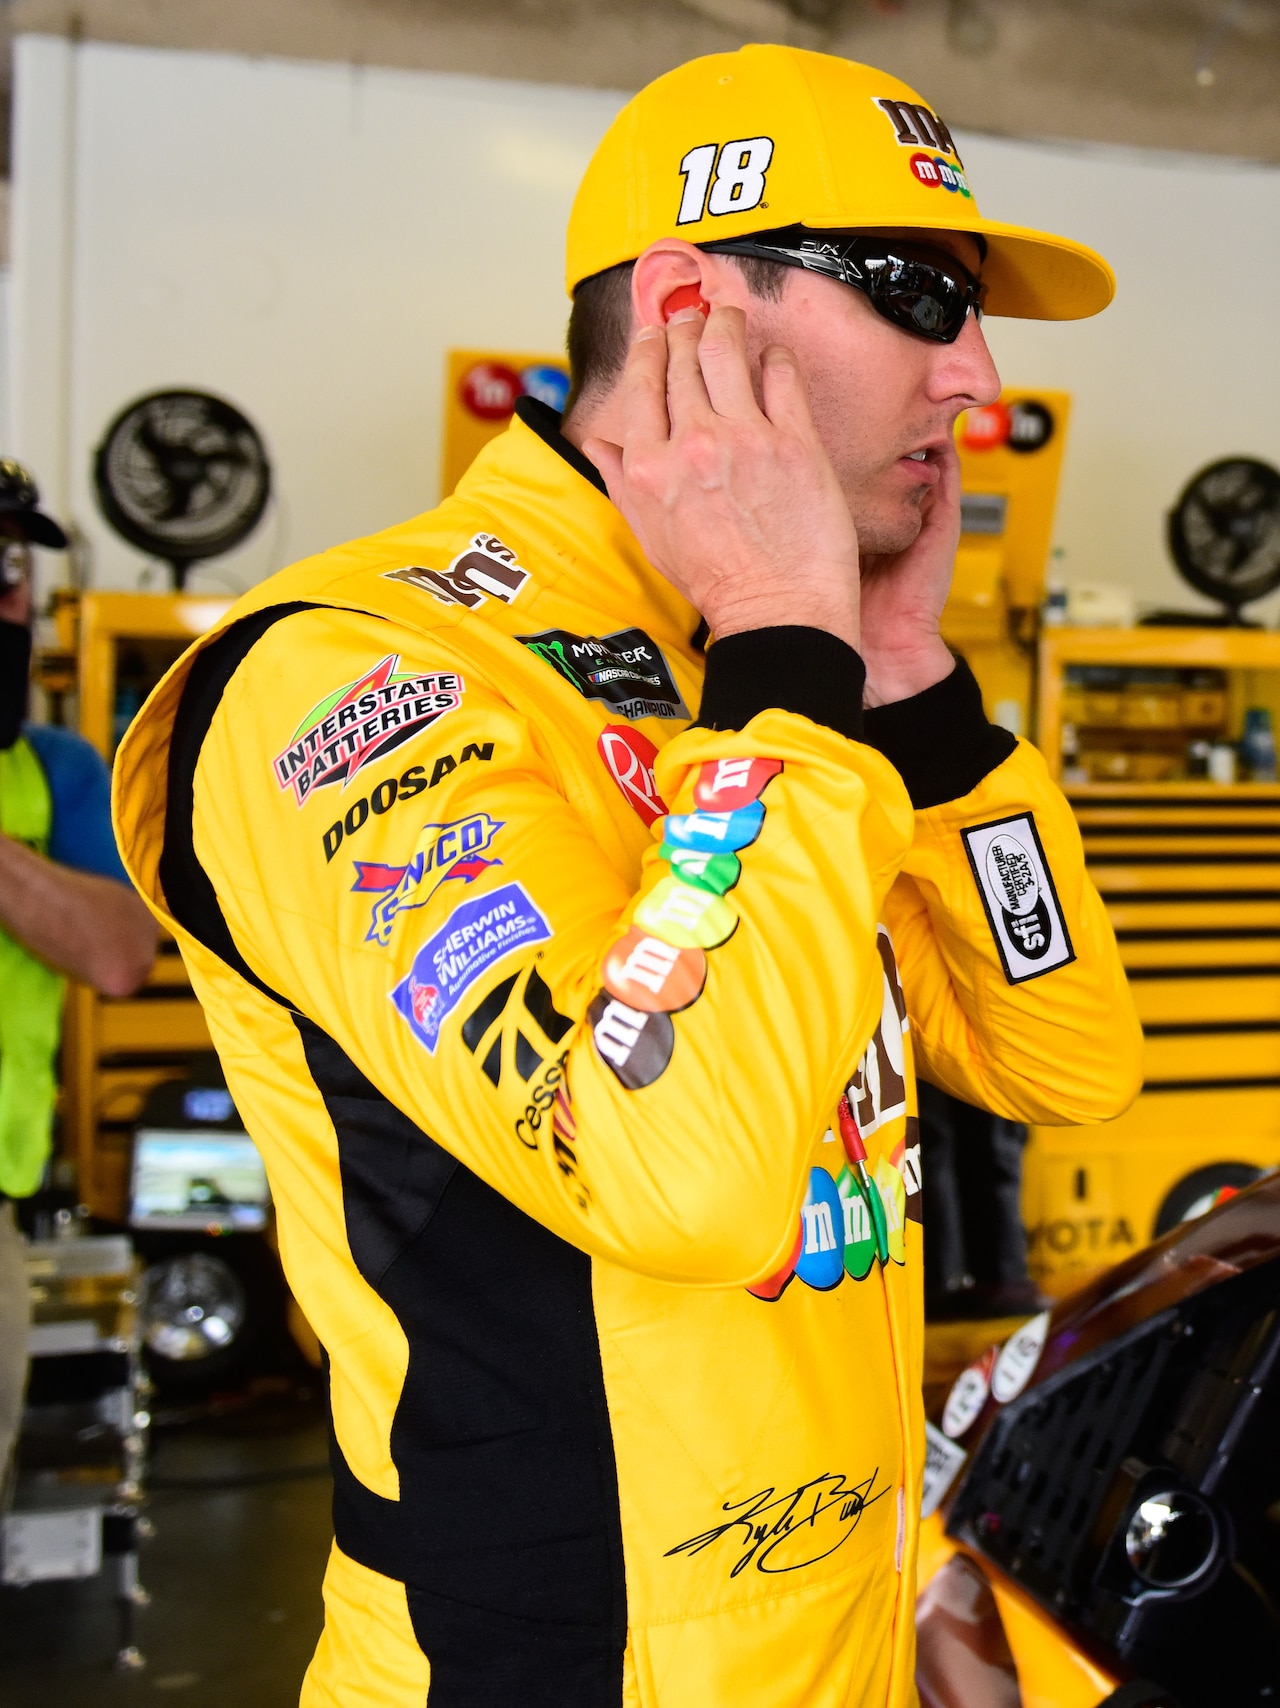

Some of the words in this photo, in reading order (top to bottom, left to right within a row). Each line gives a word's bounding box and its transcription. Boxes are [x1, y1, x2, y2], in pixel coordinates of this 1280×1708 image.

[676, 136, 775, 226] 18
[279, 675, 457, 781] INTERSTATE
[298, 693, 454, 798] BATTERIES
[322, 743, 495, 865] DOOSAN
[991, 844, 1021, 912] MANUFACTURER
[1004, 852, 1027, 897] CERTIFIED
[432, 901, 517, 973] SHERWIN
[437, 914, 527, 987] WILLIAMS
[449, 948, 498, 996] Automotive
[497, 925, 538, 951] Finishes
[622, 935, 682, 995] m
[1010, 913, 1046, 951] sfi
[593, 998, 651, 1068] m
[804, 1199, 837, 1255] m
[843, 1193, 872, 1246] m
